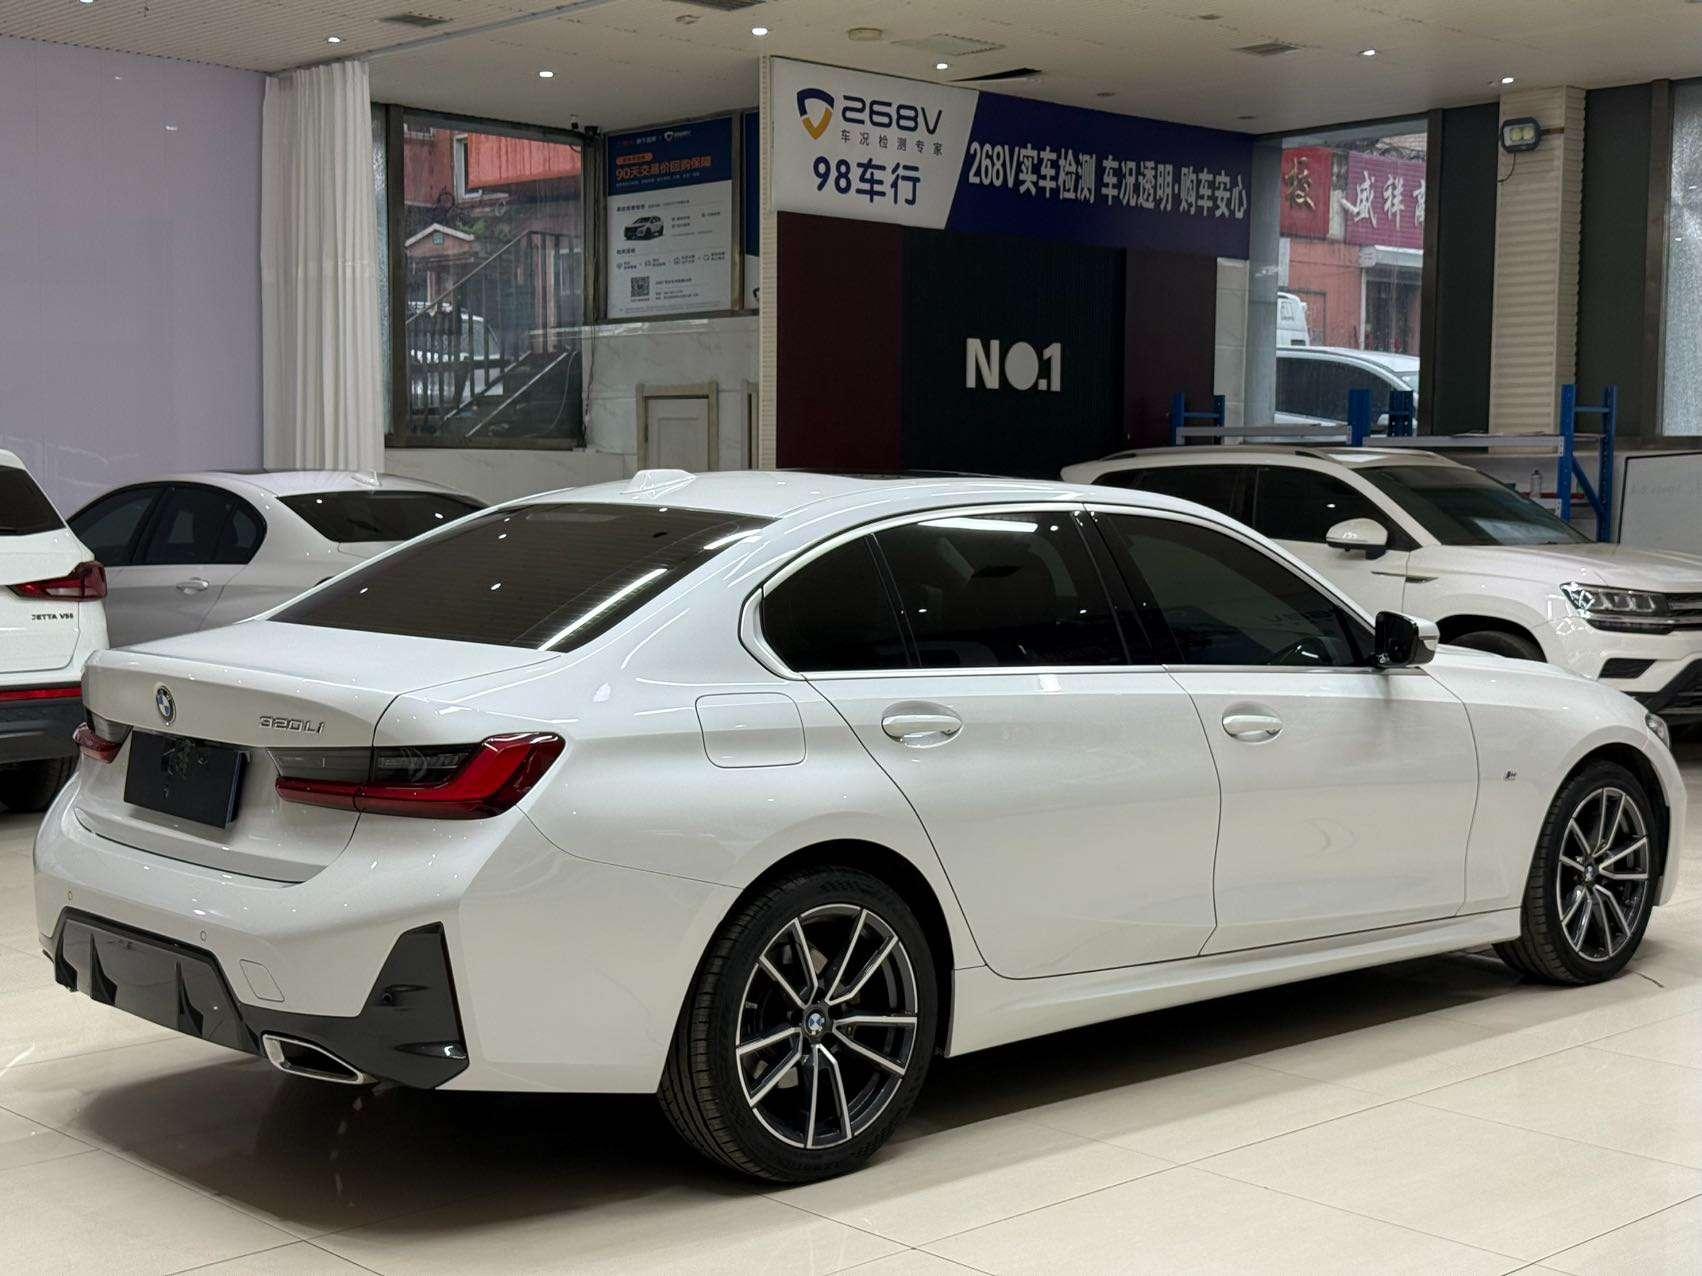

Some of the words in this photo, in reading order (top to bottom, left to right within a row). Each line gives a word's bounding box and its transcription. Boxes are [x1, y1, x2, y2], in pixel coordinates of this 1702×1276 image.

[841, 94, 943, 135] 268V
[840, 128, 944, 157] 车况检测专家
[813, 155, 921, 206] 98车行
[968, 141, 1097, 204] 268V实车检测
[965, 337, 1063, 392] NO.1
